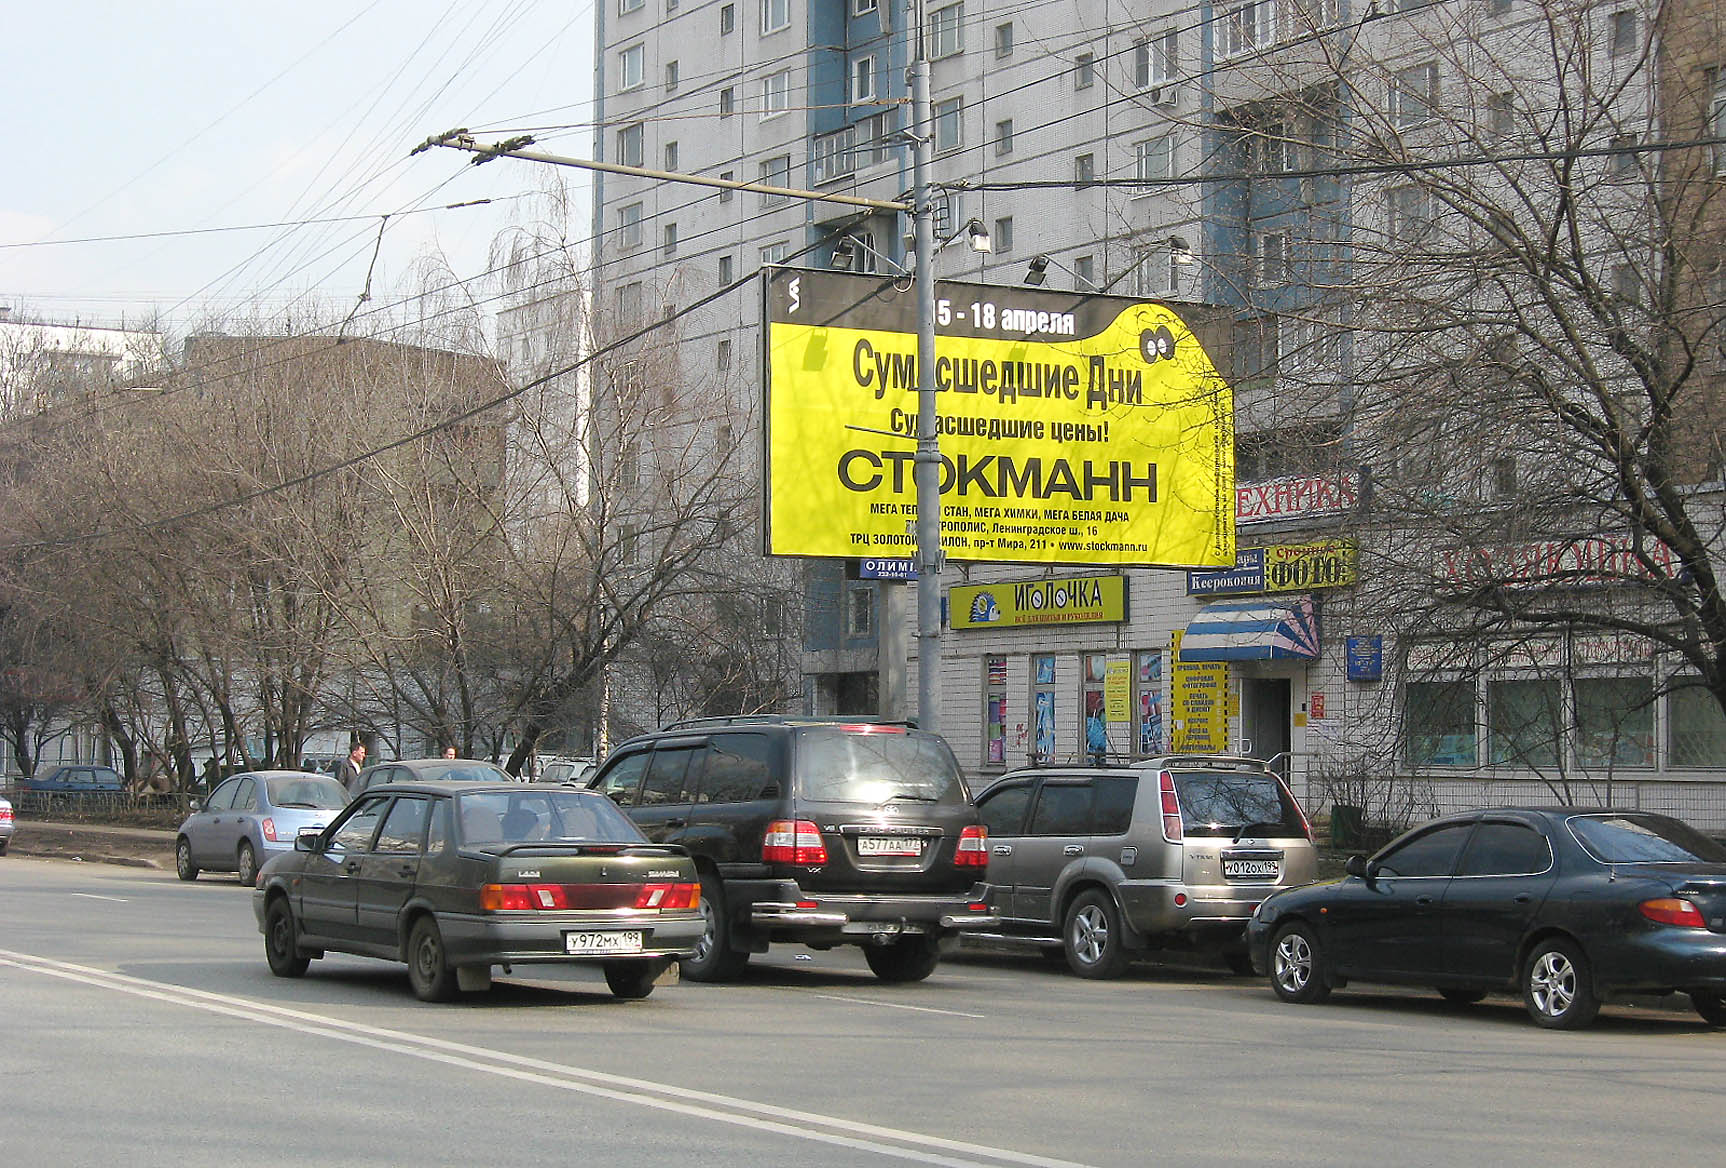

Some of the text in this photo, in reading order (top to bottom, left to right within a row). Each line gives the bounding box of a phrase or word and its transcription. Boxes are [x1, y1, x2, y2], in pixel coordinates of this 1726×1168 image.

[932, 299, 951, 326] 5
[970, 302, 996, 330] 18
[1001, 308, 1075, 336] апреля
[853, 338, 1079, 404] Сумсшедшие
[1087, 354, 1142, 411] Дни
[890, 407, 1109, 443] Суасшедшие цены!
[870, 503, 898, 515] МЕГА
[944, 506, 972, 519] СТАН,
[975, 507, 1001, 518] МЕГА
[1003, 508, 1041, 521] ХИМКИ,
[1044, 509, 1069, 521] МЕГА
[1072, 510, 1102, 521] БЕЛАЯ
[1105, 511, 1129, 523] ДАЧА
[992, 523, 1066, 537] Ленинградское
[1087, 526, 1098, 536] 16
[850, 533, 870, 546] ТРЦ
[973, 538, 995, 550] пр-т
[998, 538, 1027, 550] Мира,
[1030, 539, 1047, 549] 211
[1058, 541, 1148, 552] www.stockmann.ru
[1271, 557, 1340, 587] ФОТО
[1192, 575, 1261, 592] Ксерокопия
[571, 932, 639, 948] У972МХ 199
